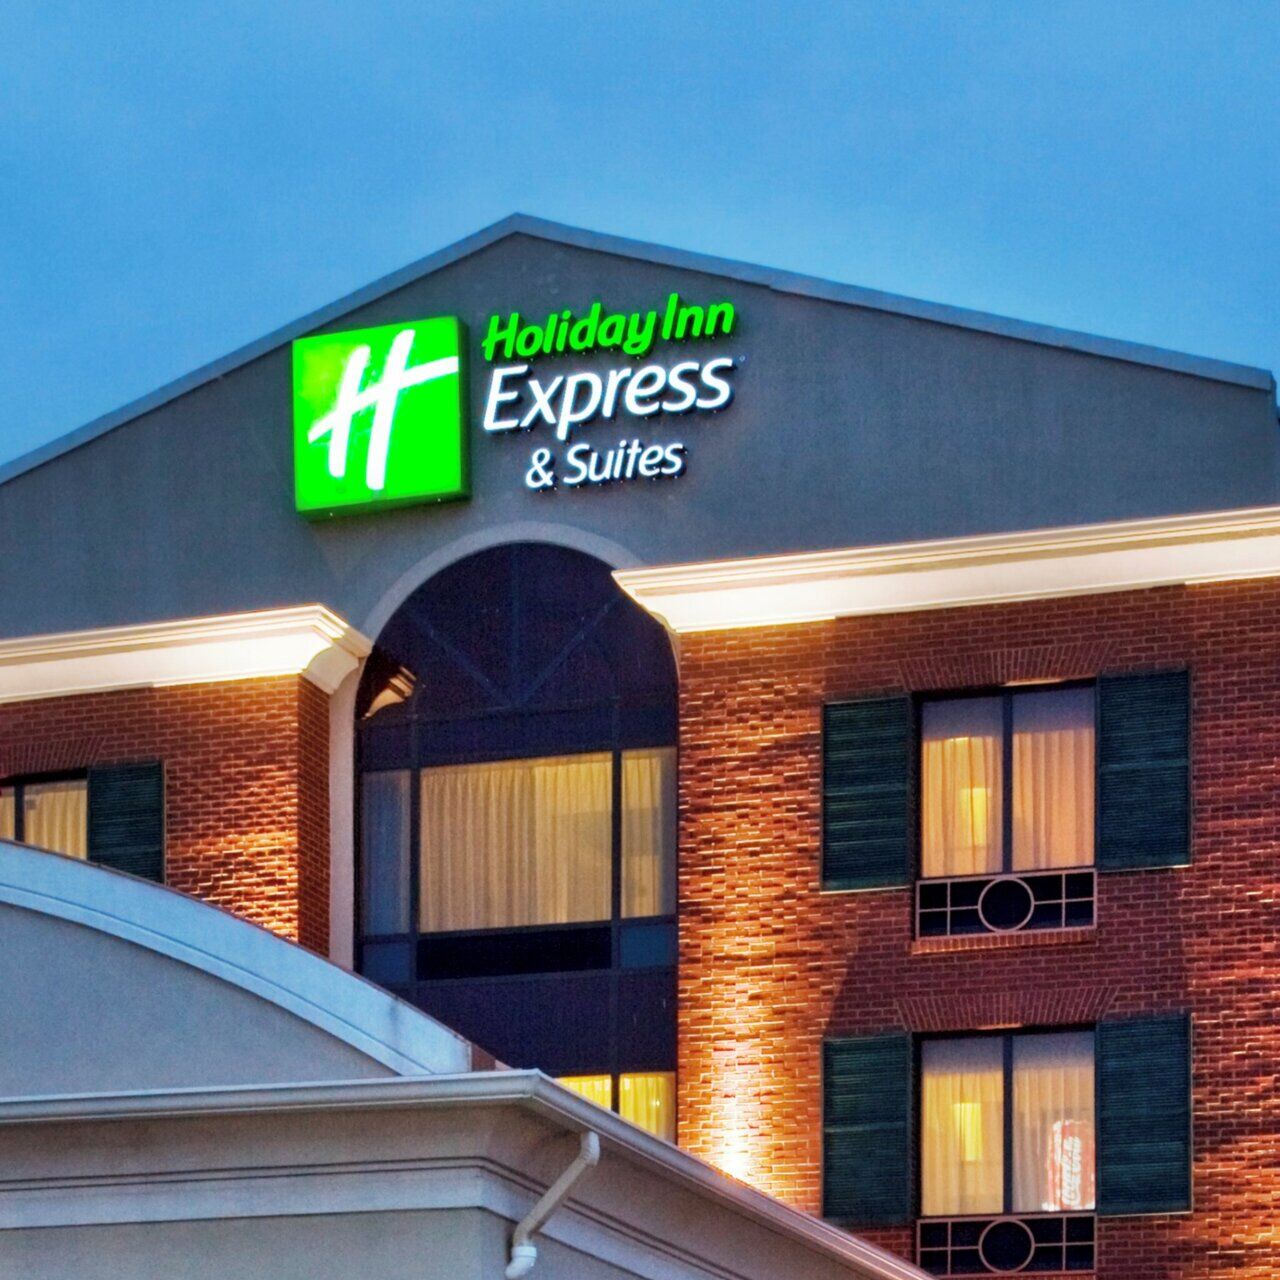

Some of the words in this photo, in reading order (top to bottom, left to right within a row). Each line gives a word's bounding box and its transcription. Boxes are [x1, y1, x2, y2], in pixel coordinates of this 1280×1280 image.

[481, 303, 656, 361] Holiday
[662, 293, 735, 340] Inn
[483, 357, 733, 440] Express
[525, 448, 554, 489] &
[563, 439, 684, 485] Suites
